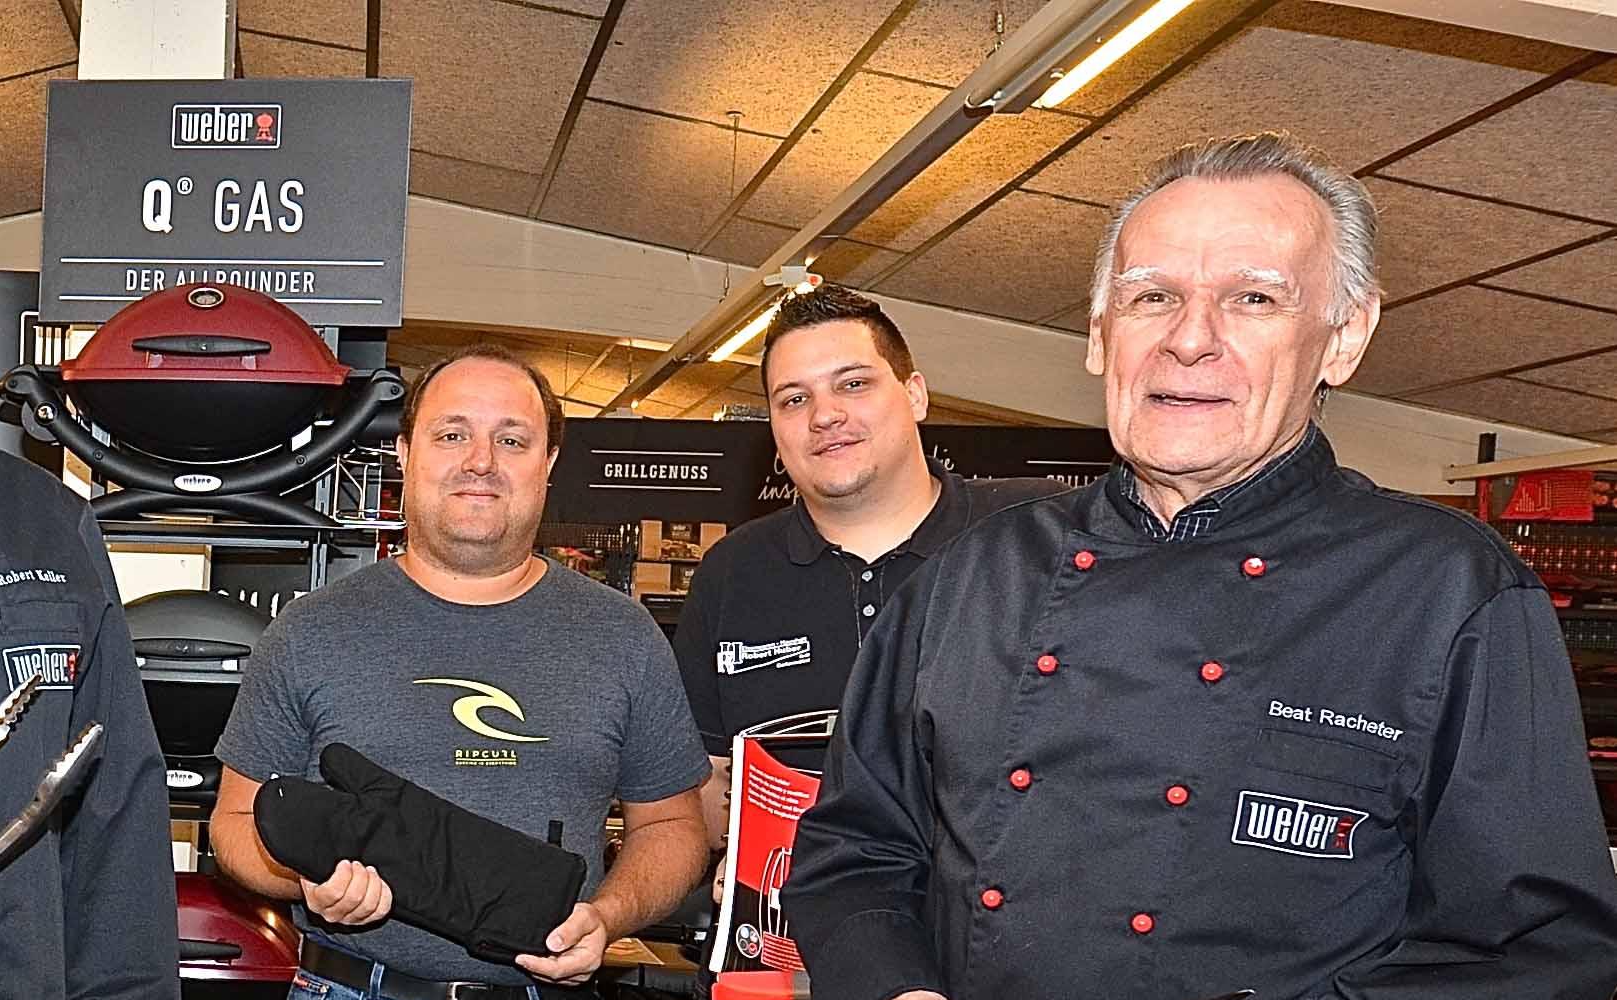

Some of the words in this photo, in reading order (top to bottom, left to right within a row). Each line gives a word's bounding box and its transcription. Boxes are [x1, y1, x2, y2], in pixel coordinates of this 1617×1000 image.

[180, 106, 253, 142] weber
[214, 179, 304, 233] GAS
[126, 269, 165, 291] DER
[604, 463, 709, 480] GRILLGENUSS
[12, 648, 69, 682] weber
[1268, 700, 1313, 721] Beat
[1319, 709, 1404, 741] Racheter
[1247, 800, 1339, 850] weber
